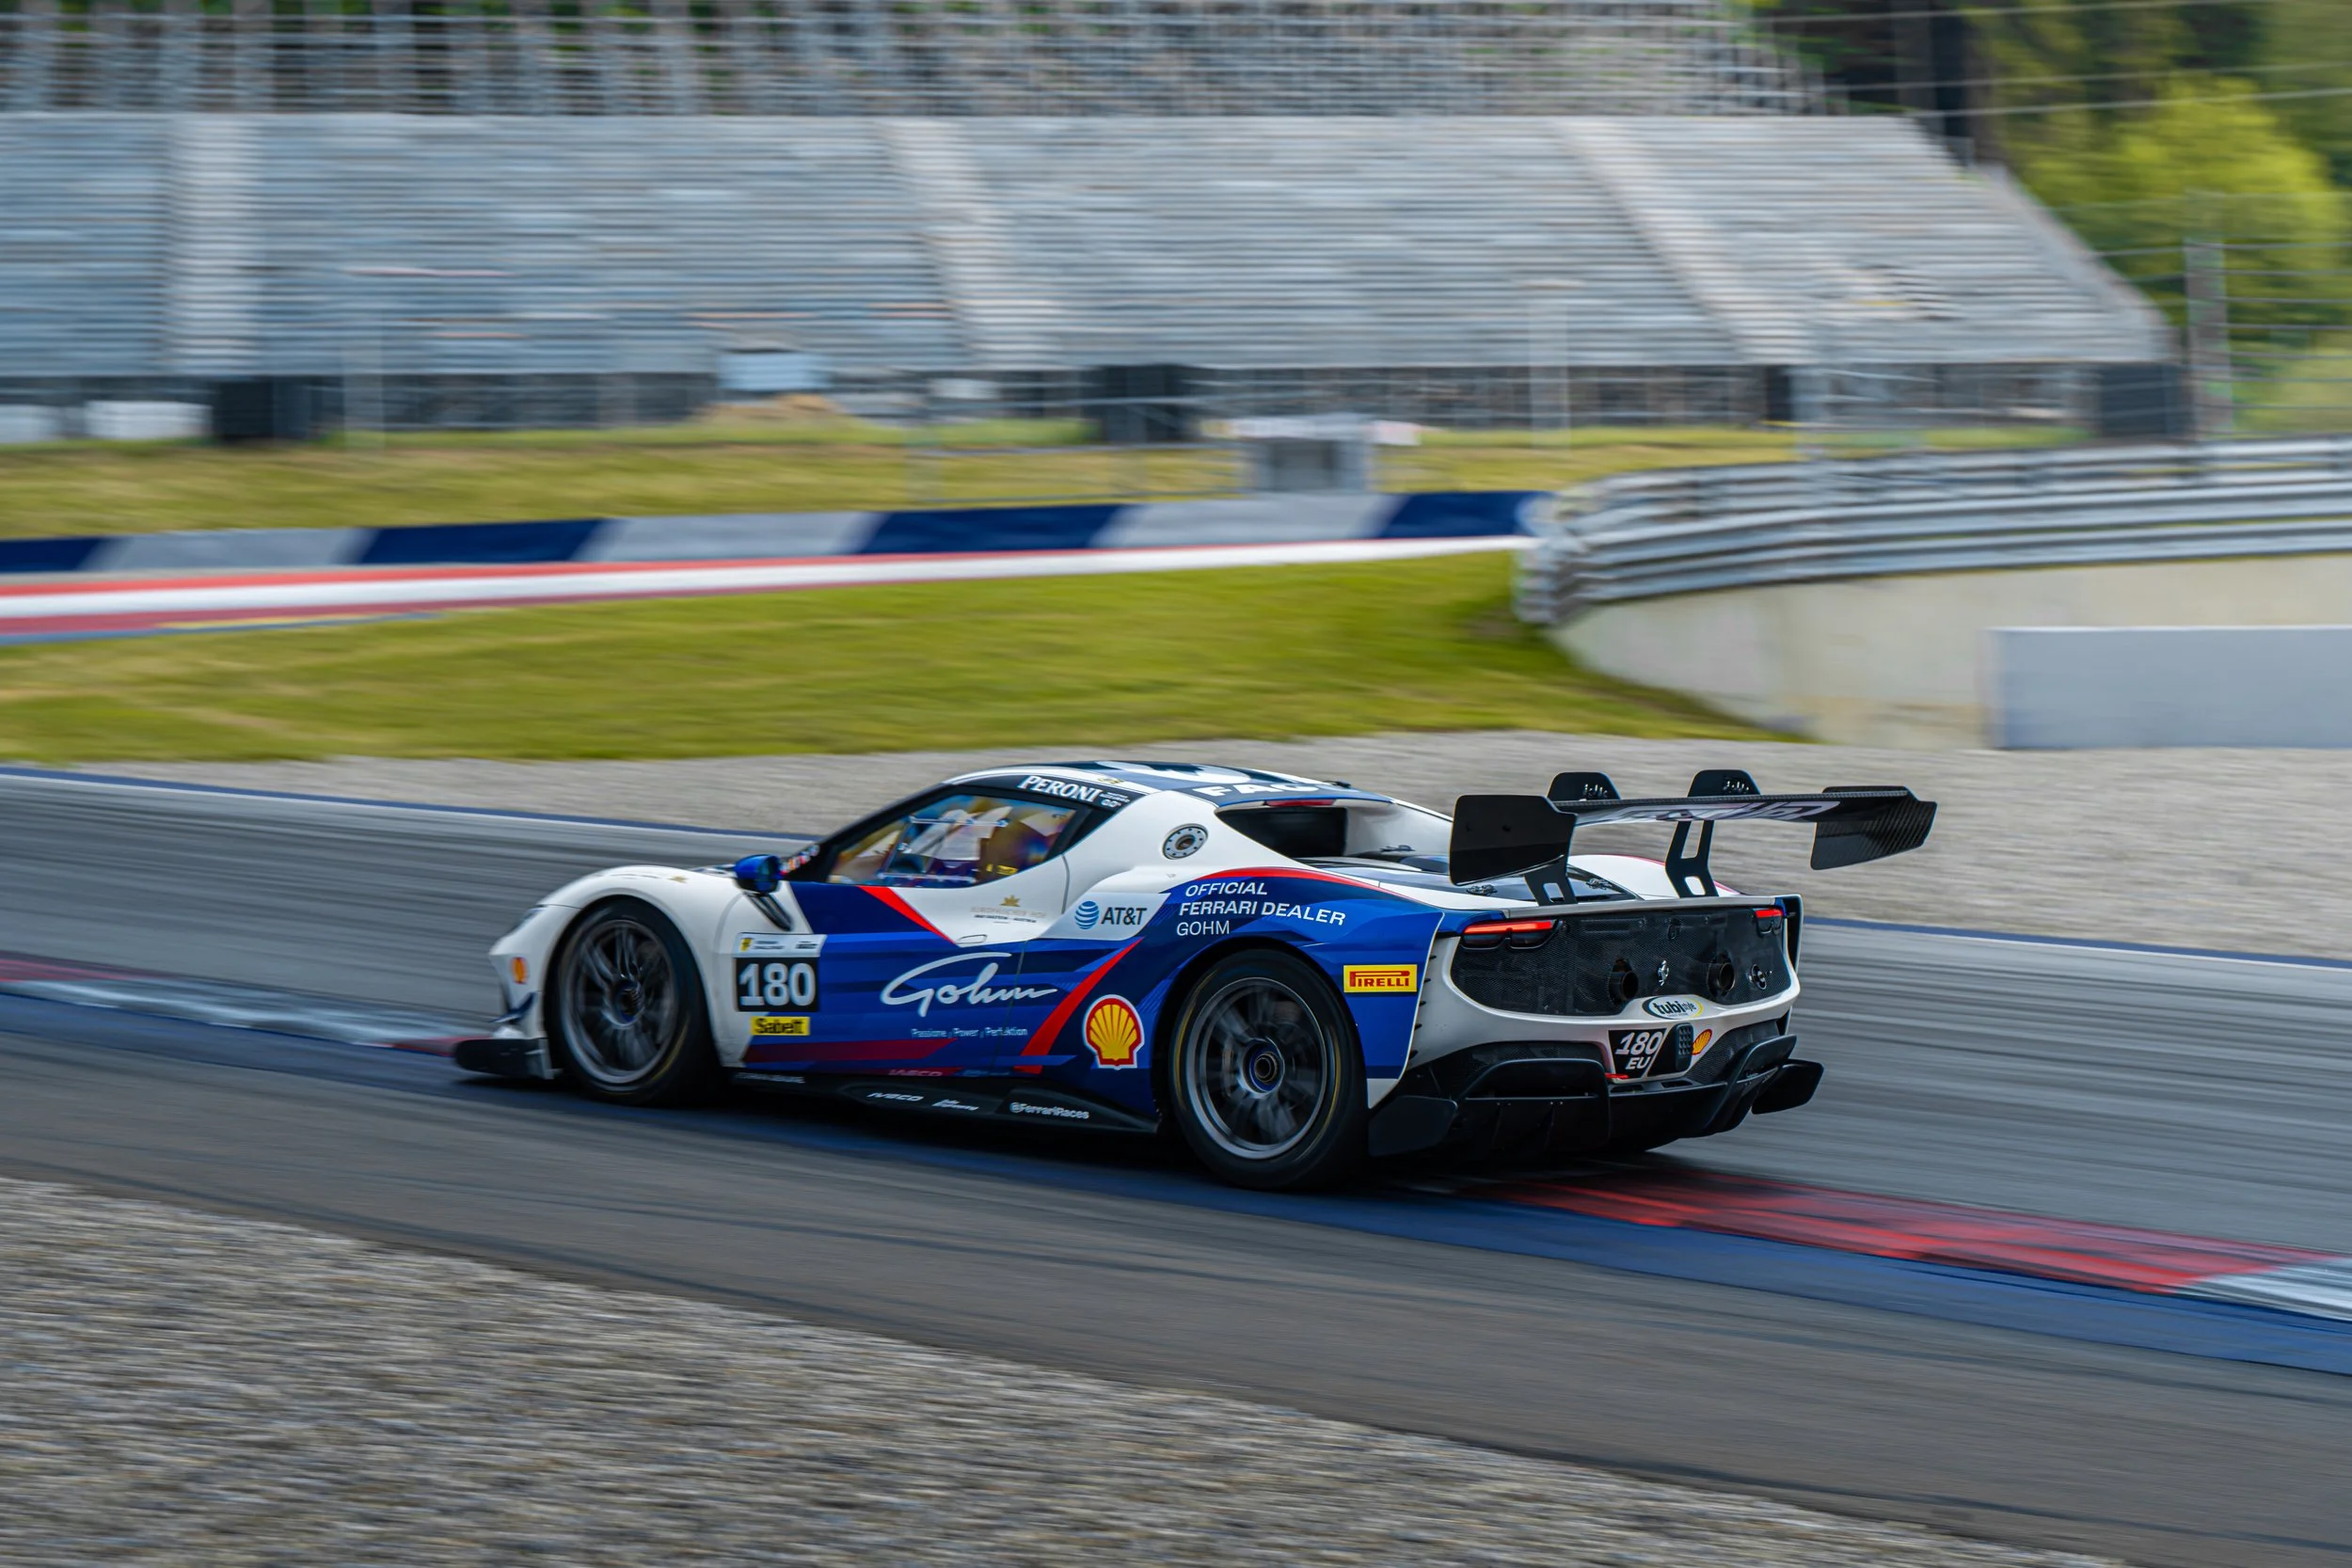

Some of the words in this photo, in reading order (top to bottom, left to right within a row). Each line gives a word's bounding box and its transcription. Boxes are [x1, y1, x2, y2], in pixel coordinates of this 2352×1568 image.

[1017, 775, 1104, 802] PERONI
[1184, 881, 1268, 897] OFFICIAL
[1100, 907, 1148, 926] AT&T
[1178, 900, 1258, 917] FERRARI
[1260, 902, 1346, 927] DEALER
[1176, 920, 1231, 937] GOHM
[739, 962, 817, 1006] 180
[879, 951, 1058, 1018] Gohm
[1348, 971, 1410, 988] PIRELLI
[1614, 1031, 1663, 1055] 180
[1625, 1056, 1651, 1070] EU
